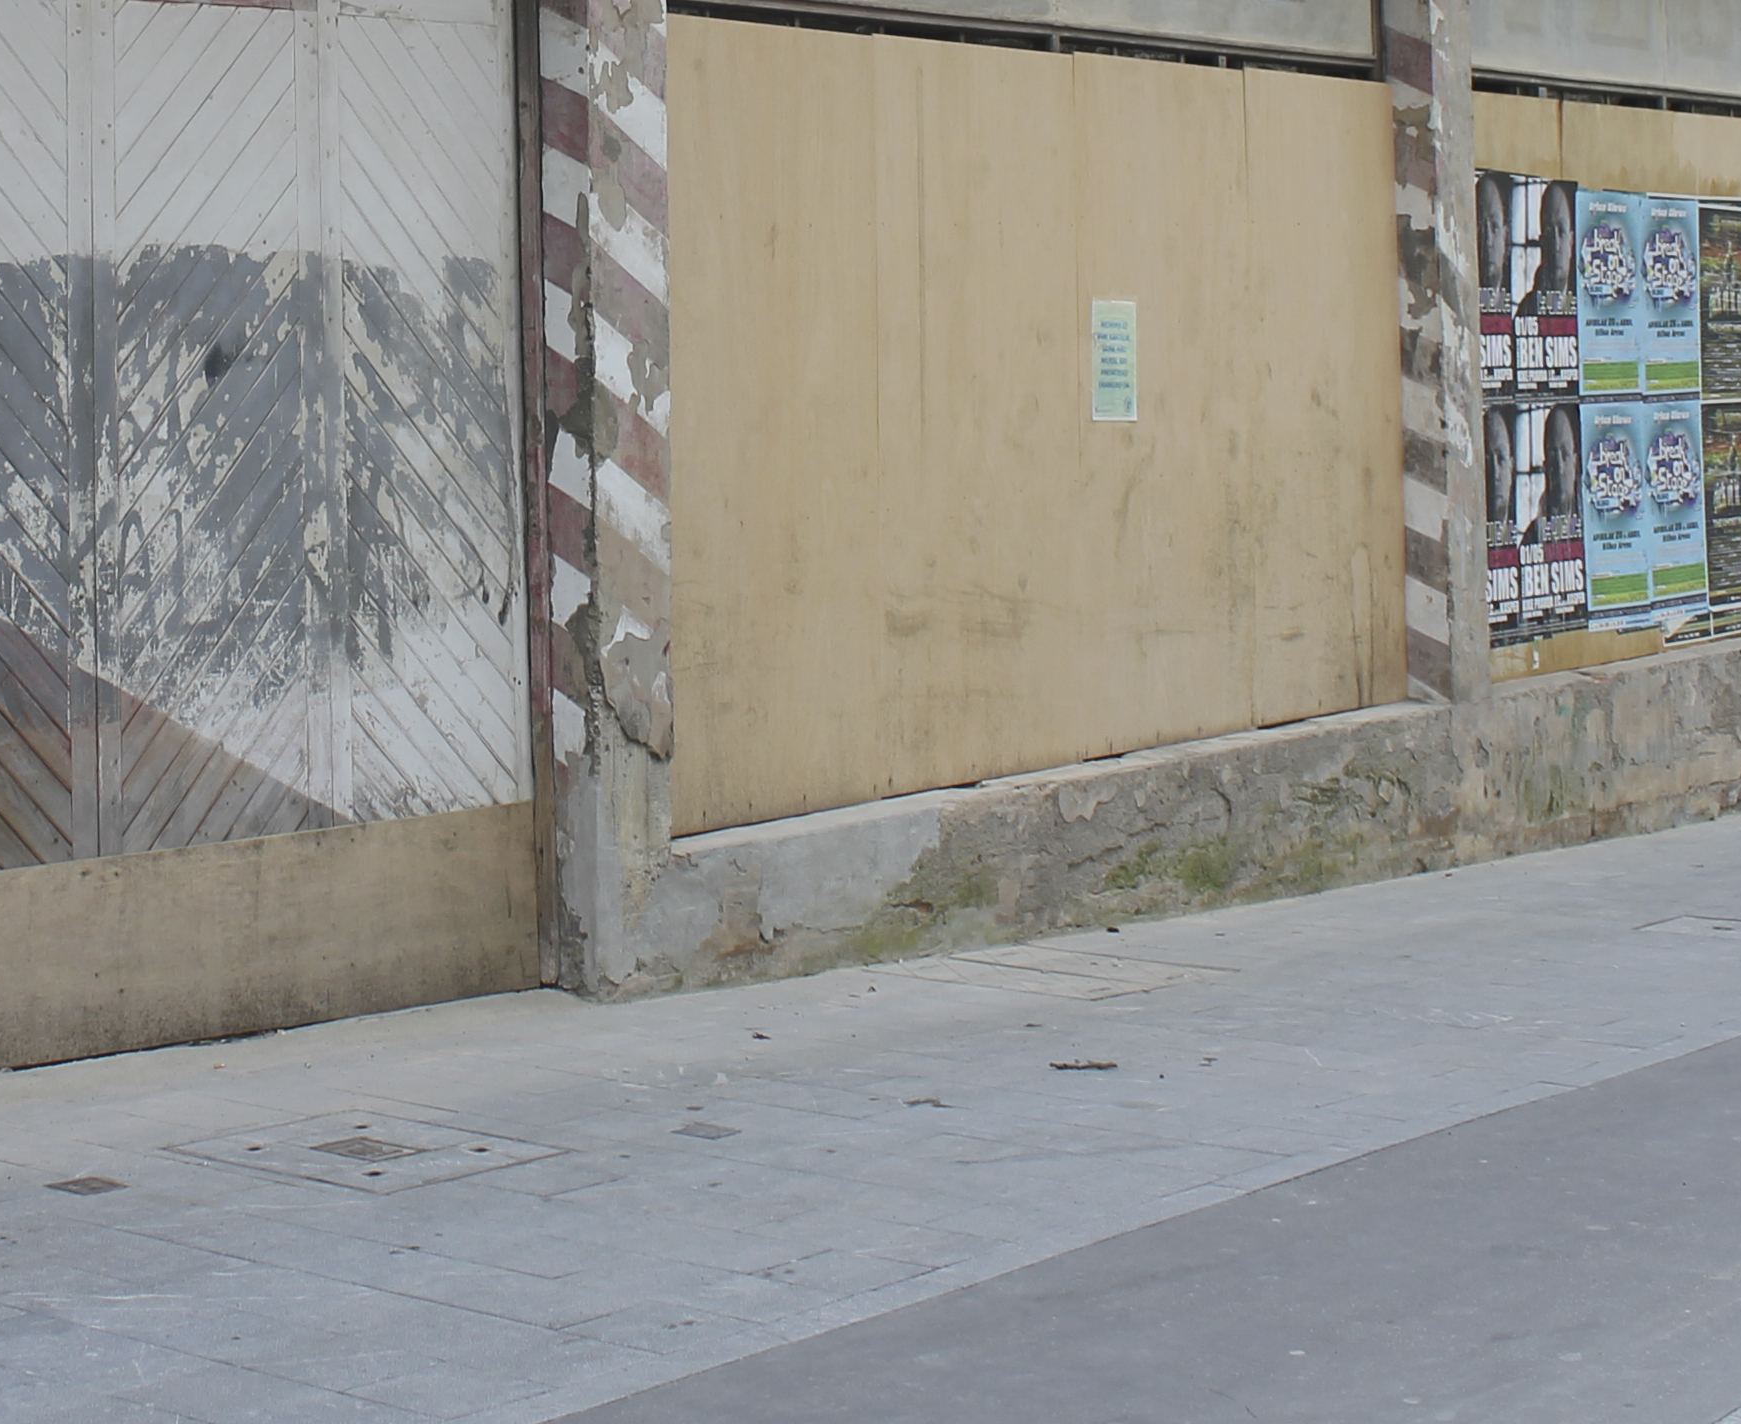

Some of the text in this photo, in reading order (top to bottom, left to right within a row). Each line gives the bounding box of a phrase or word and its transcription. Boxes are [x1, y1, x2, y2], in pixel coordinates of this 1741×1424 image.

[1520, 336, 1577, 368] BEN SIMS
[1525, 559, 1584, 597] BEN SIMS
